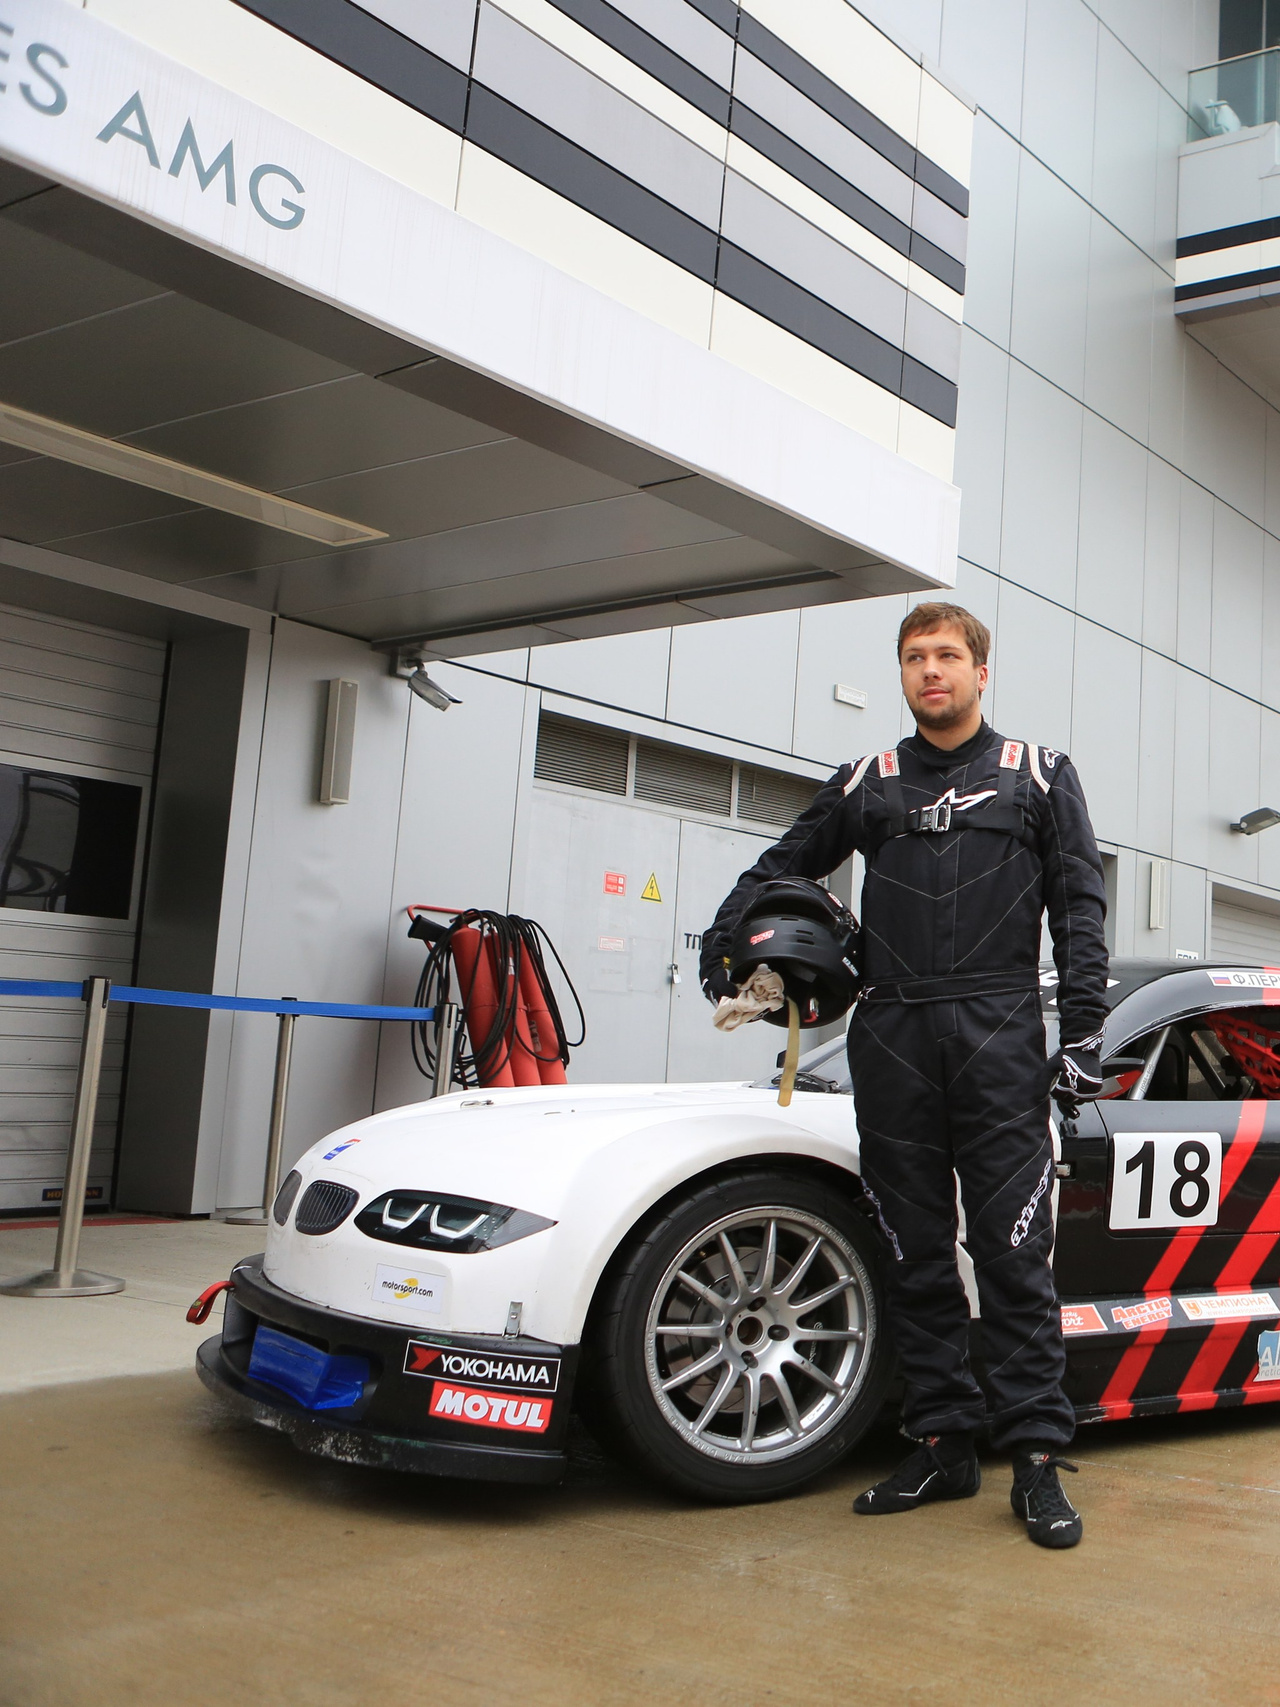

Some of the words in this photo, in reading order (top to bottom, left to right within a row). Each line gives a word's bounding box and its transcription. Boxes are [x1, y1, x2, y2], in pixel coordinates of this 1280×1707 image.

[96, 90, 306, 230] AMG
[885, 751, 895, 774] SIMPSON
[1005, 744, 1018, 767] SIMPSON
[1124, 1139, 1211, 1219] 18
[382, 1279, 433, 1298] motorsport.com
[1112, 1299, 1171, 1322] ARCTIC
[1199, 1296, 1271, 1309] ЧЕМПИОНАТ
[1123, 1307, 1172, 1329] ENERGY
[441, 1354, 550, 1384] YOKOHAMA
[435, 1388, 544, 1428] MOTUL
